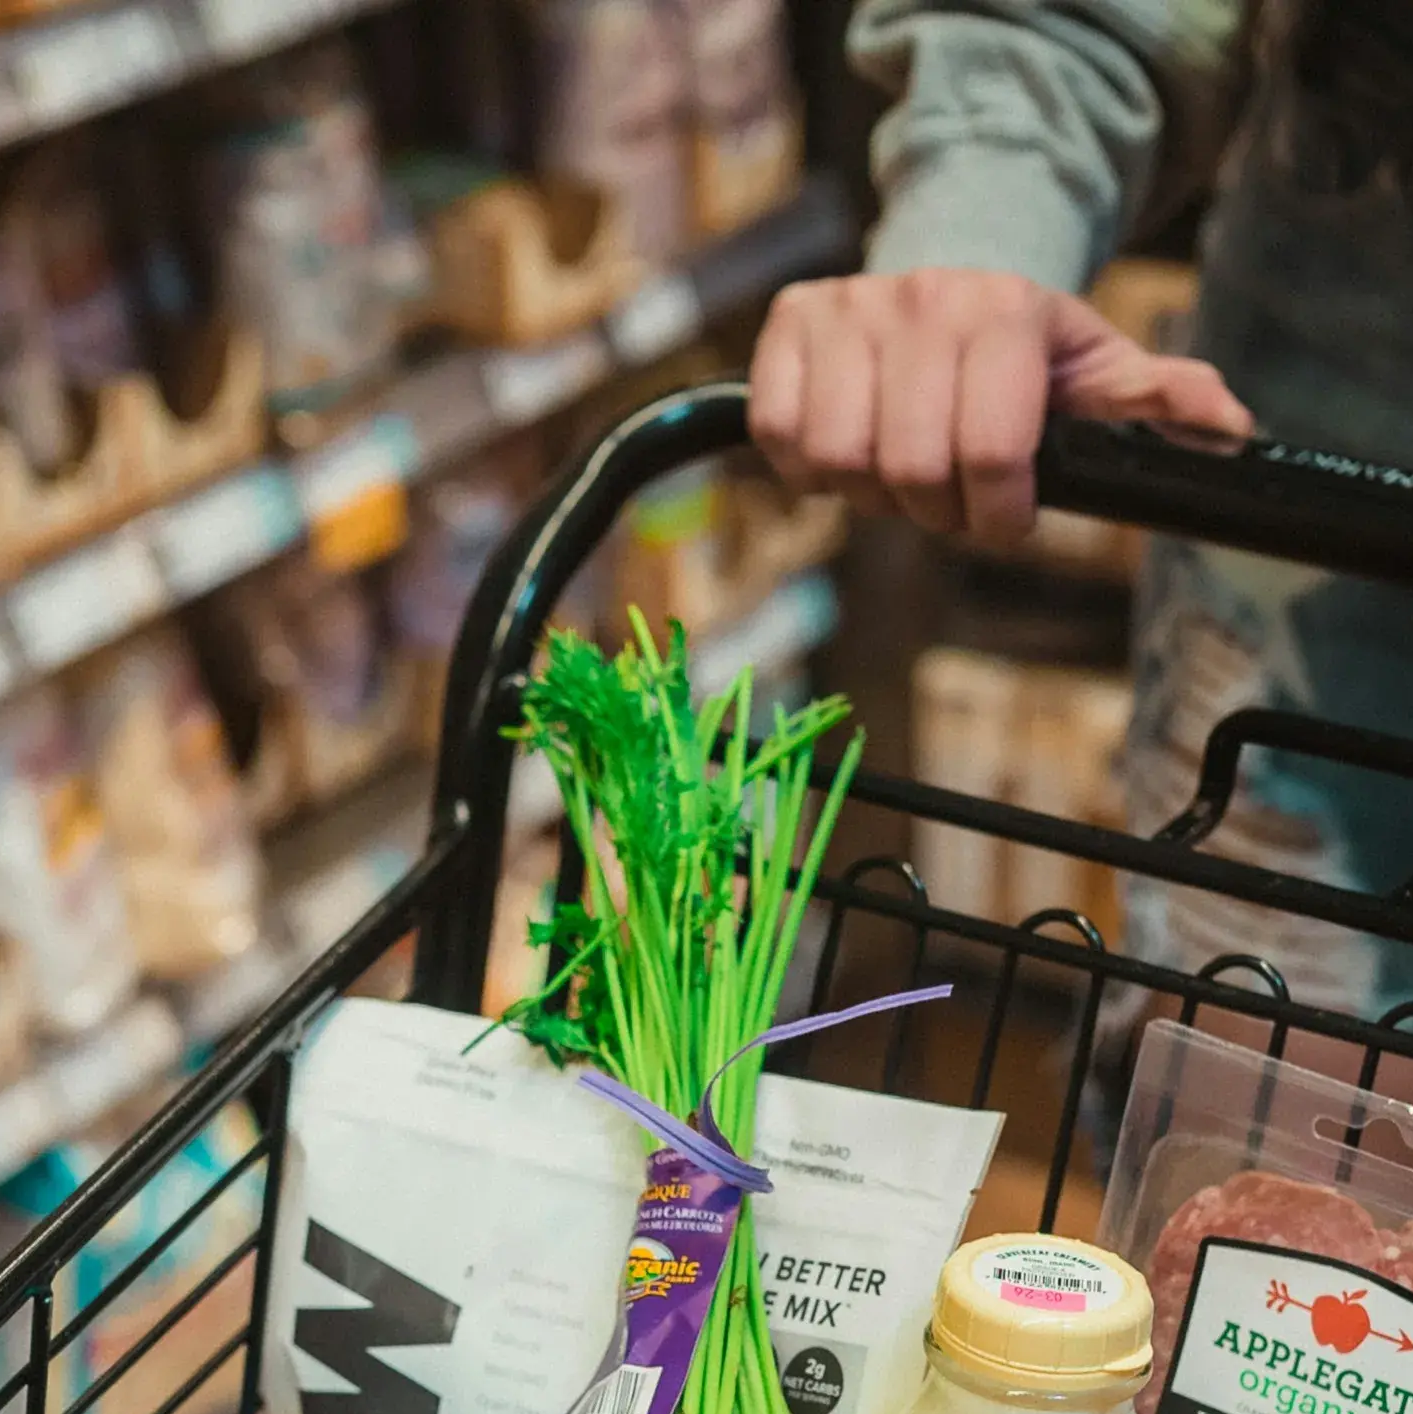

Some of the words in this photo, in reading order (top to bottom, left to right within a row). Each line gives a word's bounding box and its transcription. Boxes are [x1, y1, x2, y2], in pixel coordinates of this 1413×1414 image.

[776, 1256, 886, 1296] BETTER
[1014, 1287, 1063, 1303] 03-26
[783, 1294, 842, 1328] MIX
[804, 1358, 826, 1380] 2g
[804, 1379, 841, 1397] CARBS
